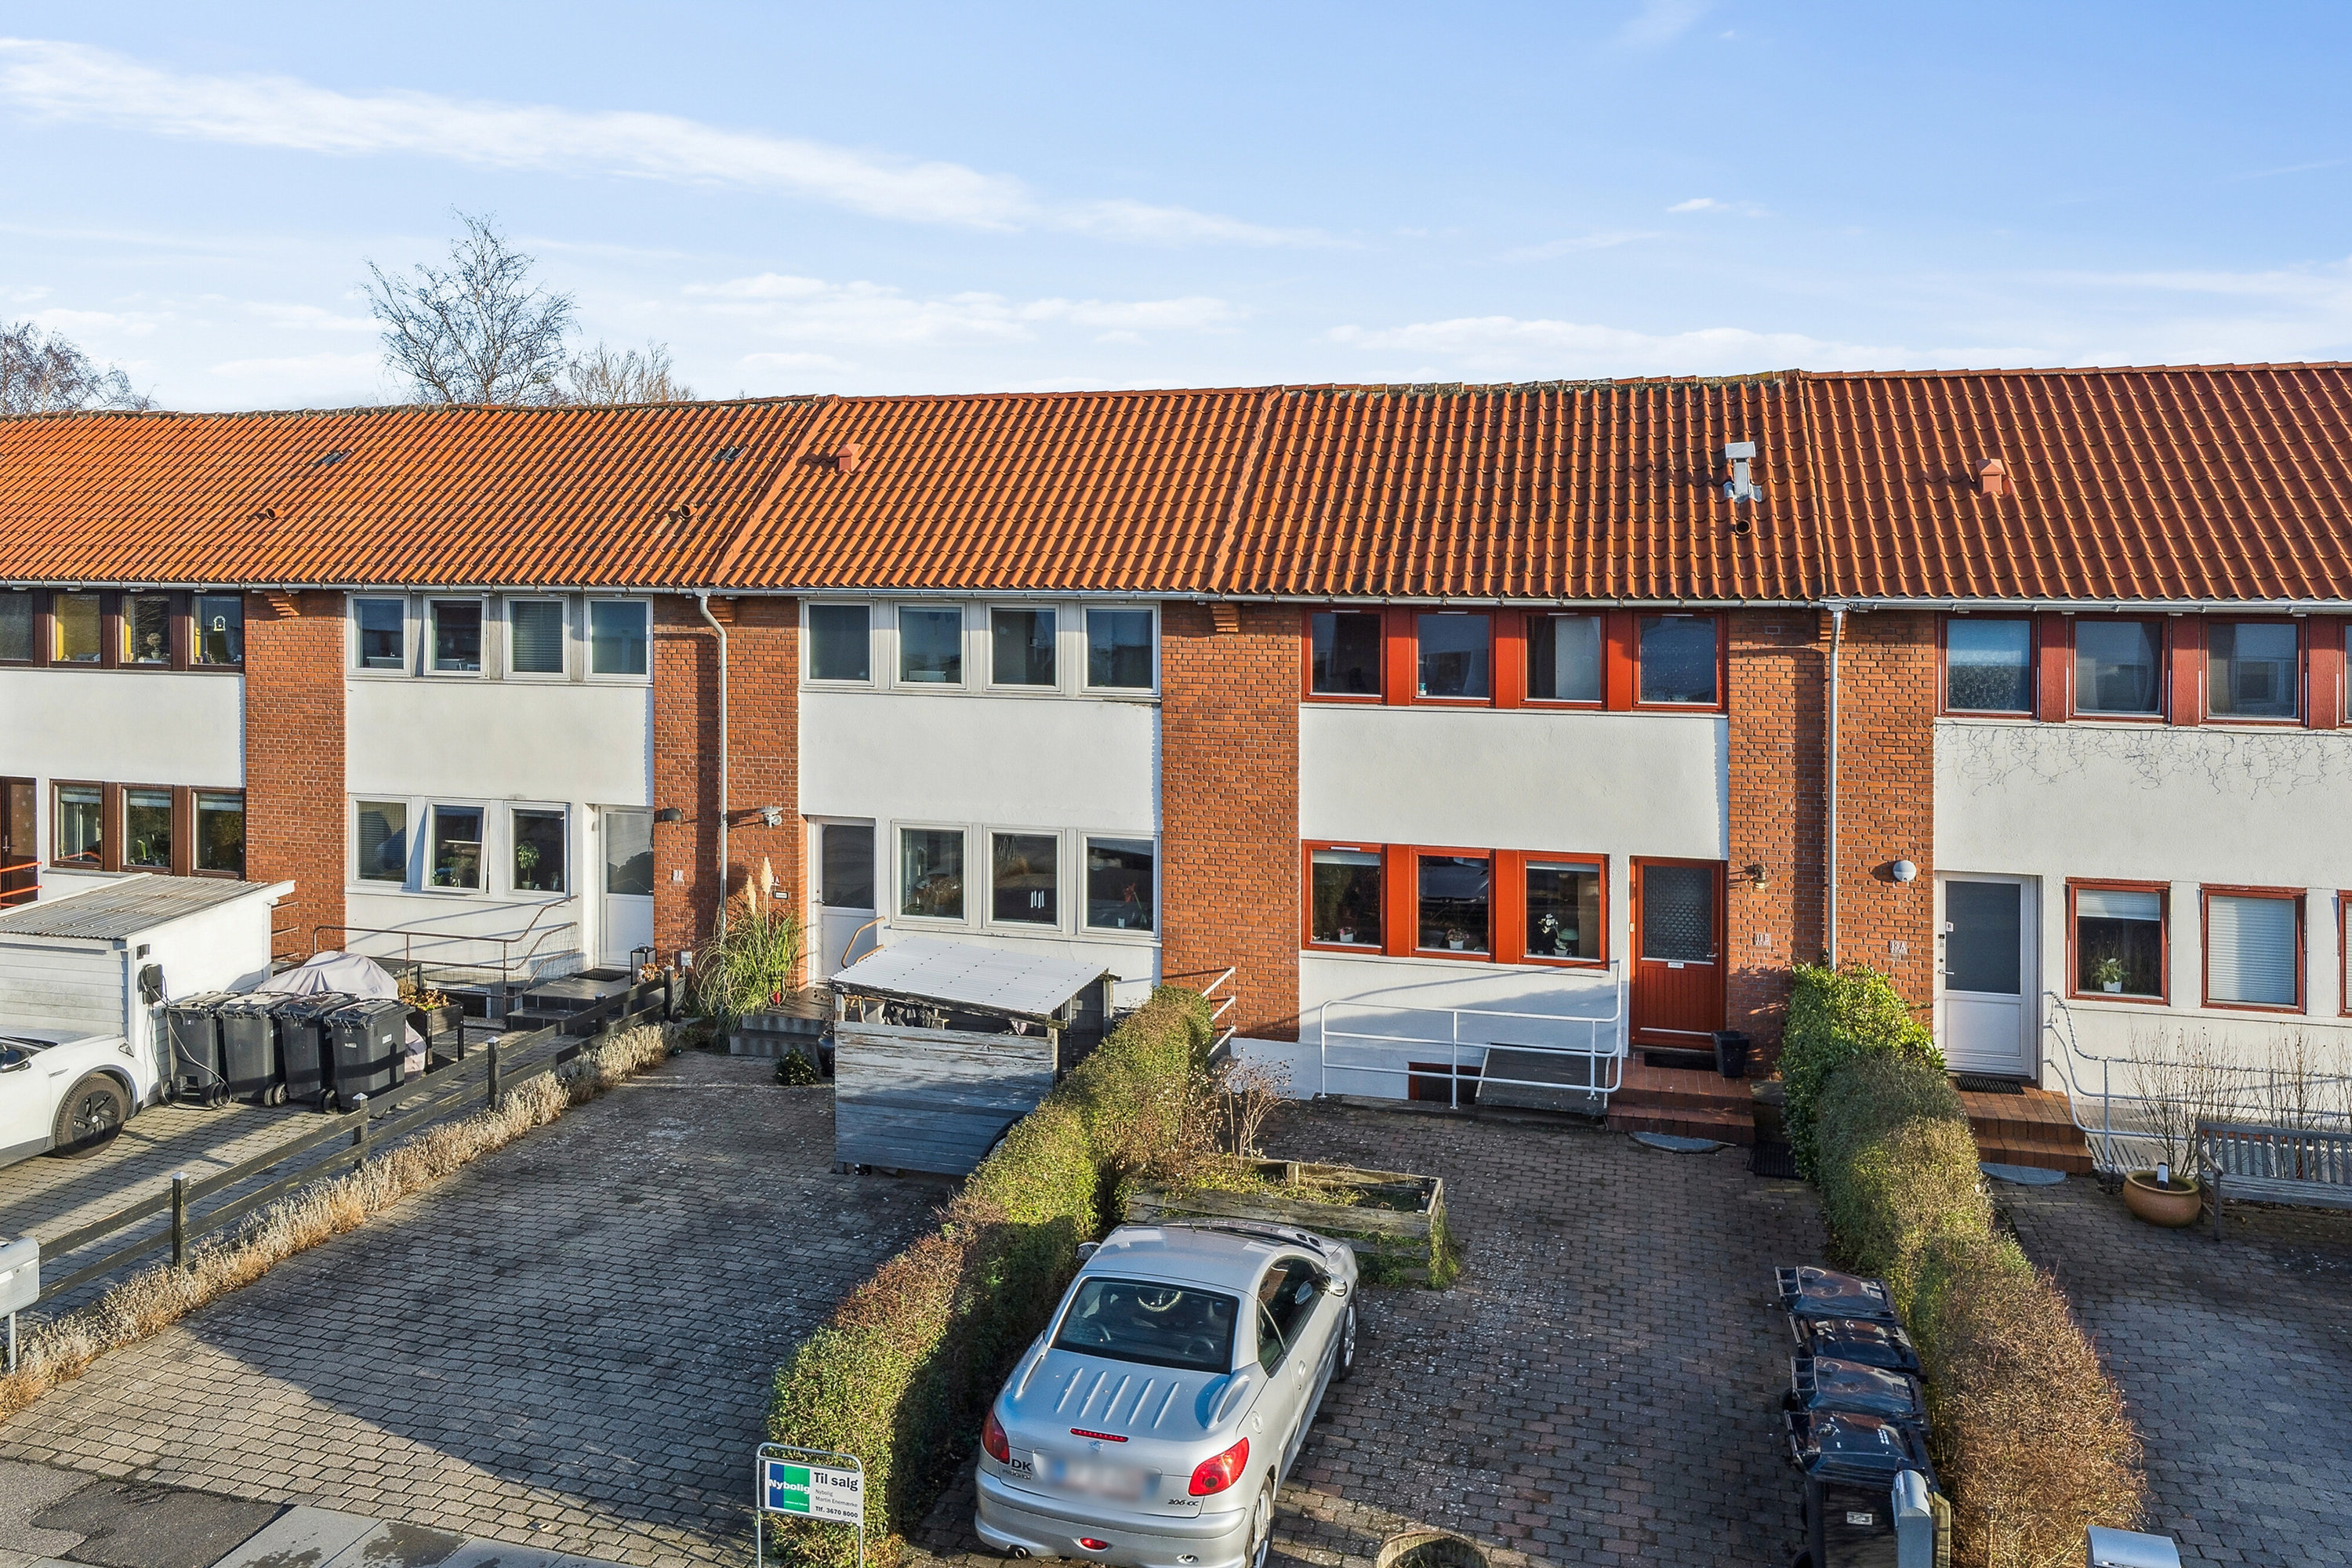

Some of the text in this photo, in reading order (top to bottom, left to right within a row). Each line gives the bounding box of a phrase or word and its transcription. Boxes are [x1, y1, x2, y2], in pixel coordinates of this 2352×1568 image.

[1011, 1458, 1033, 1472] DK
[768, 1478, 811, 1495] Nybolig
[814, 1472, 859, 1492] Til salg
[826, 1507, 842, 1516] 3670
[842, 1510, 858, 1519] 8000
